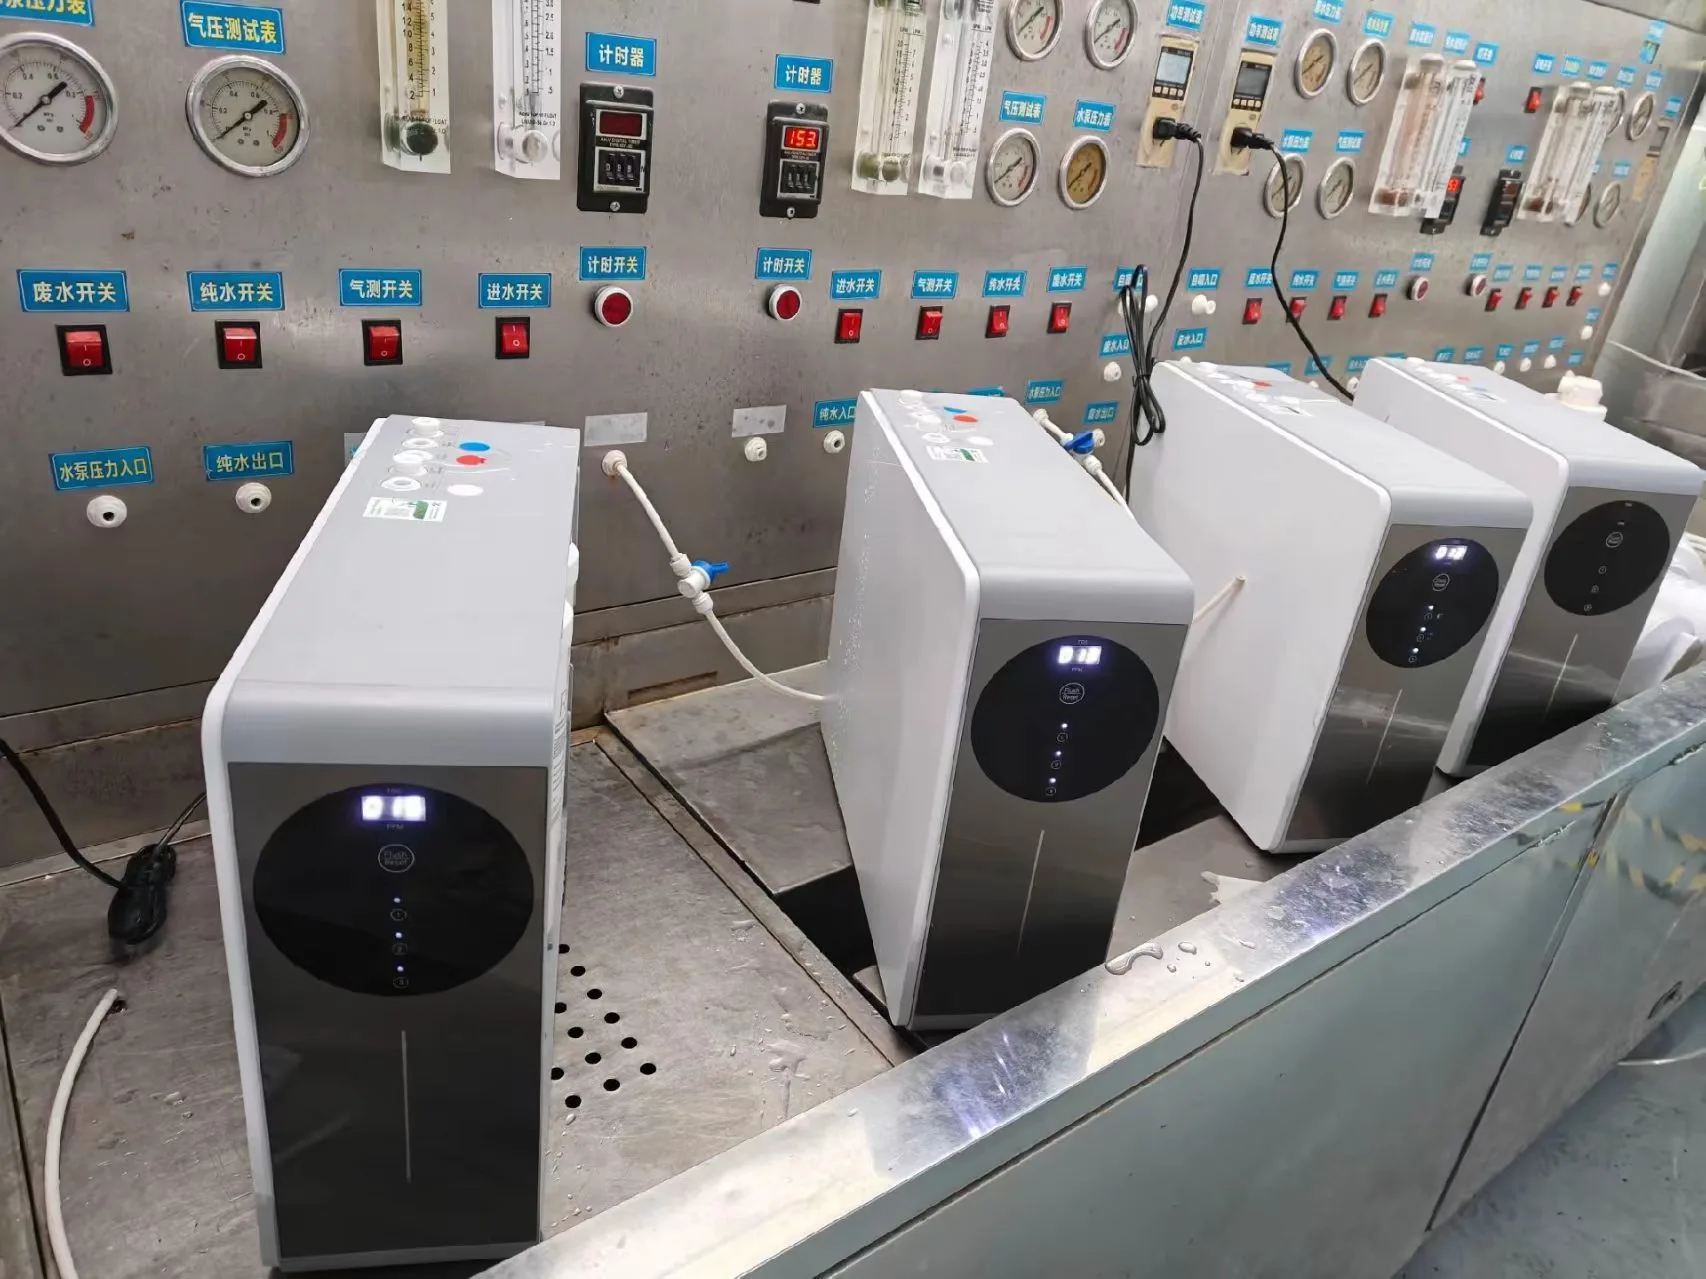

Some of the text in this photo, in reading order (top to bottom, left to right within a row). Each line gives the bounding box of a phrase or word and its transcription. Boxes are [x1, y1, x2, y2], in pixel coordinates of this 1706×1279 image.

[402, 17, 412, 26] 12
[430, 13, 435, 21] 5
[188, 12, 278, 44] 气压测试表
[403, 29, 412, 38] 10
[408, 43, 413, 52] 8
[599, 44, 645, 67] 计时器
[408, 58, 413, 66] 6
[431, 66, 436, 75] 2
[408, 73, 413, 82] 4
[785, 65, 822, 85] 计时器
[410, 91, 415, 100] 2
[1003, 100, 1042, 119] 气压测试表
[1076, 108, 1113, 127] 水泵压力表
[587, 256, 638, 274] 计时开关
[762, 256, 805, 274] 计时开关
[33, 281, 117, 304] 废水开关
[199, 282, 274, 303] 纯水开关
[349, 278, 413, 299] 气测开关
[486, 282, 543, 301] 进水开关
[836, 276, 875, 294] 进水开关
[917, 277, 952, 293] 气测开关
[819, 406, 857, 422] 纯水入口
[59, 457, 148, 482] 水泵压力入口
[215, 451, 284, 473] 纯水出口
